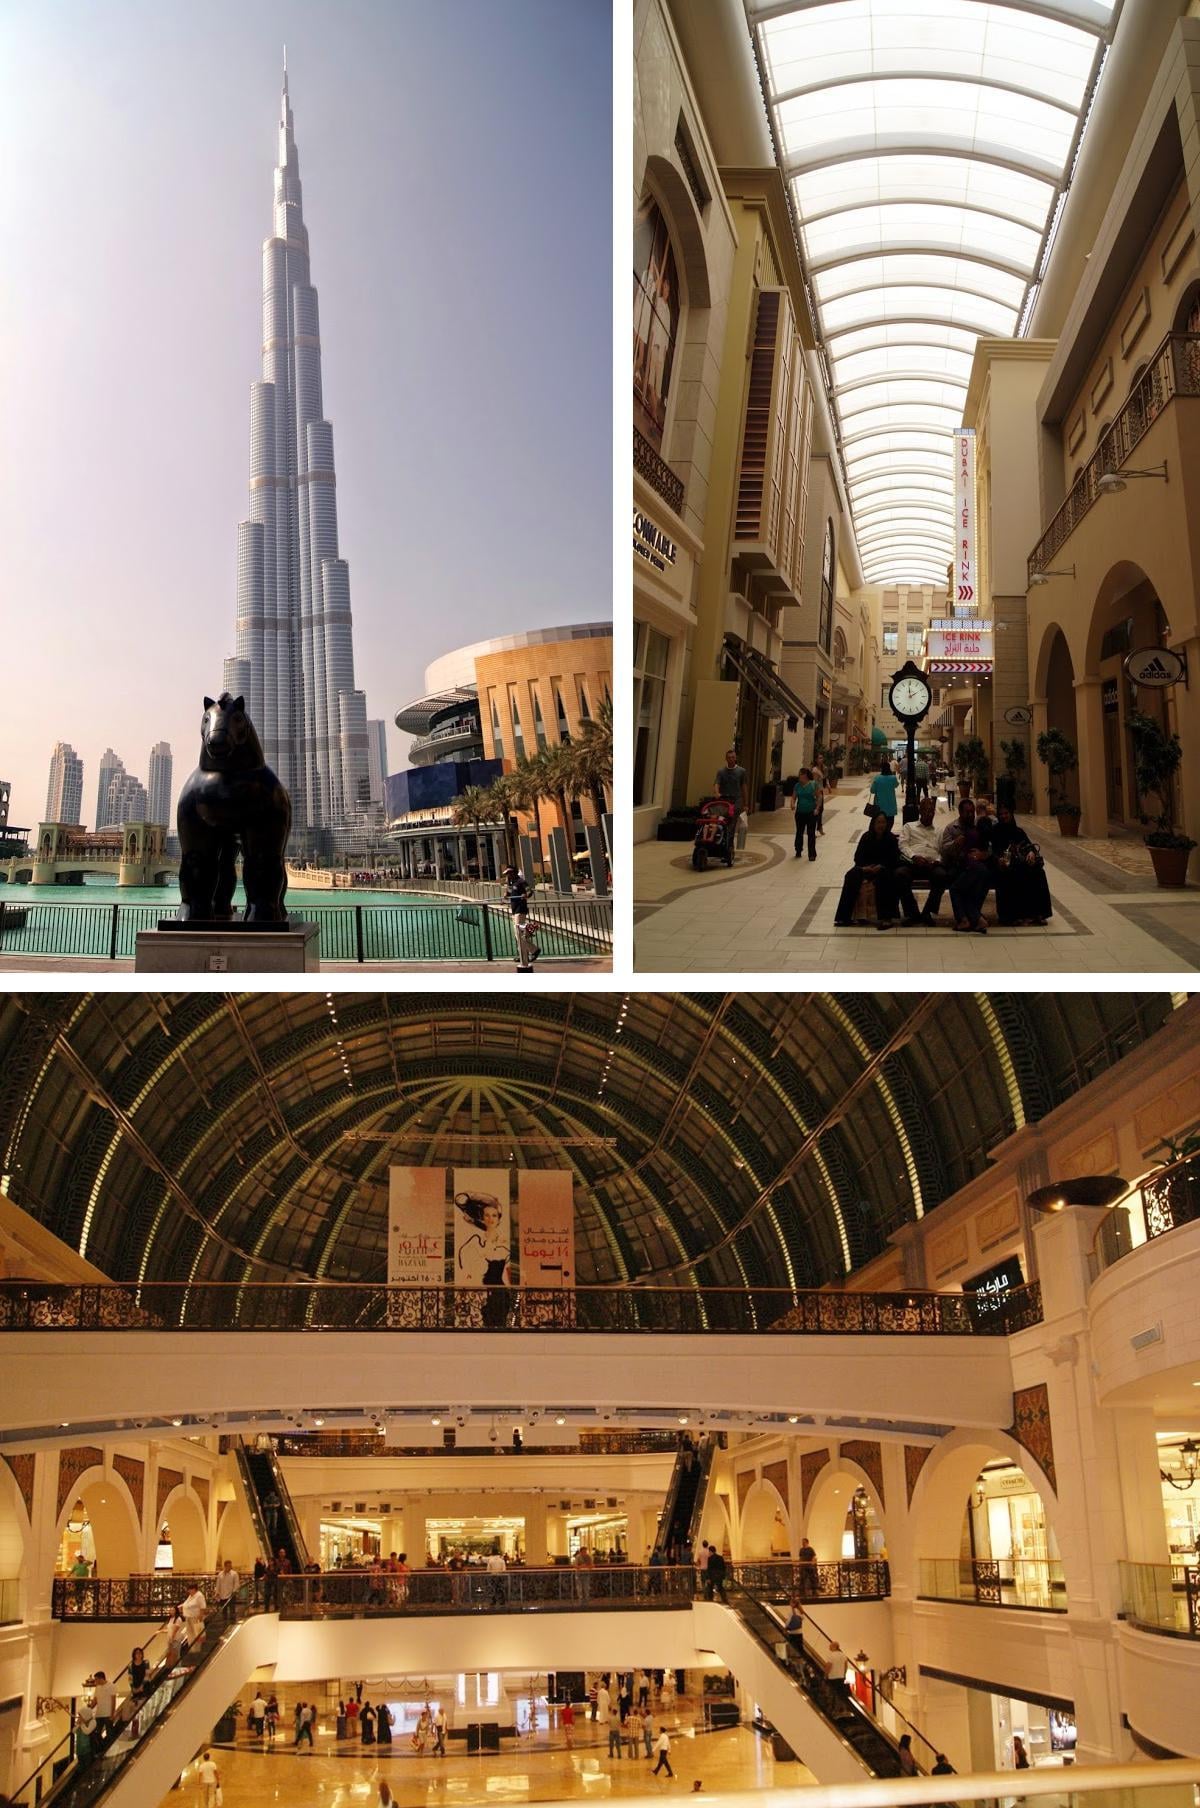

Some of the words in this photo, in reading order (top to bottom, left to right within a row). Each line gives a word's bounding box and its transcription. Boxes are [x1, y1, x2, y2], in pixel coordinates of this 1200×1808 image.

[961, 438, 969, 487] DUBAI
[962, 539, 970, 582] RINK
[942, 631, 957, 641] ICE
[959, 631, 981, 641] RINK
[1139, 671, 1172, 679] adidas
